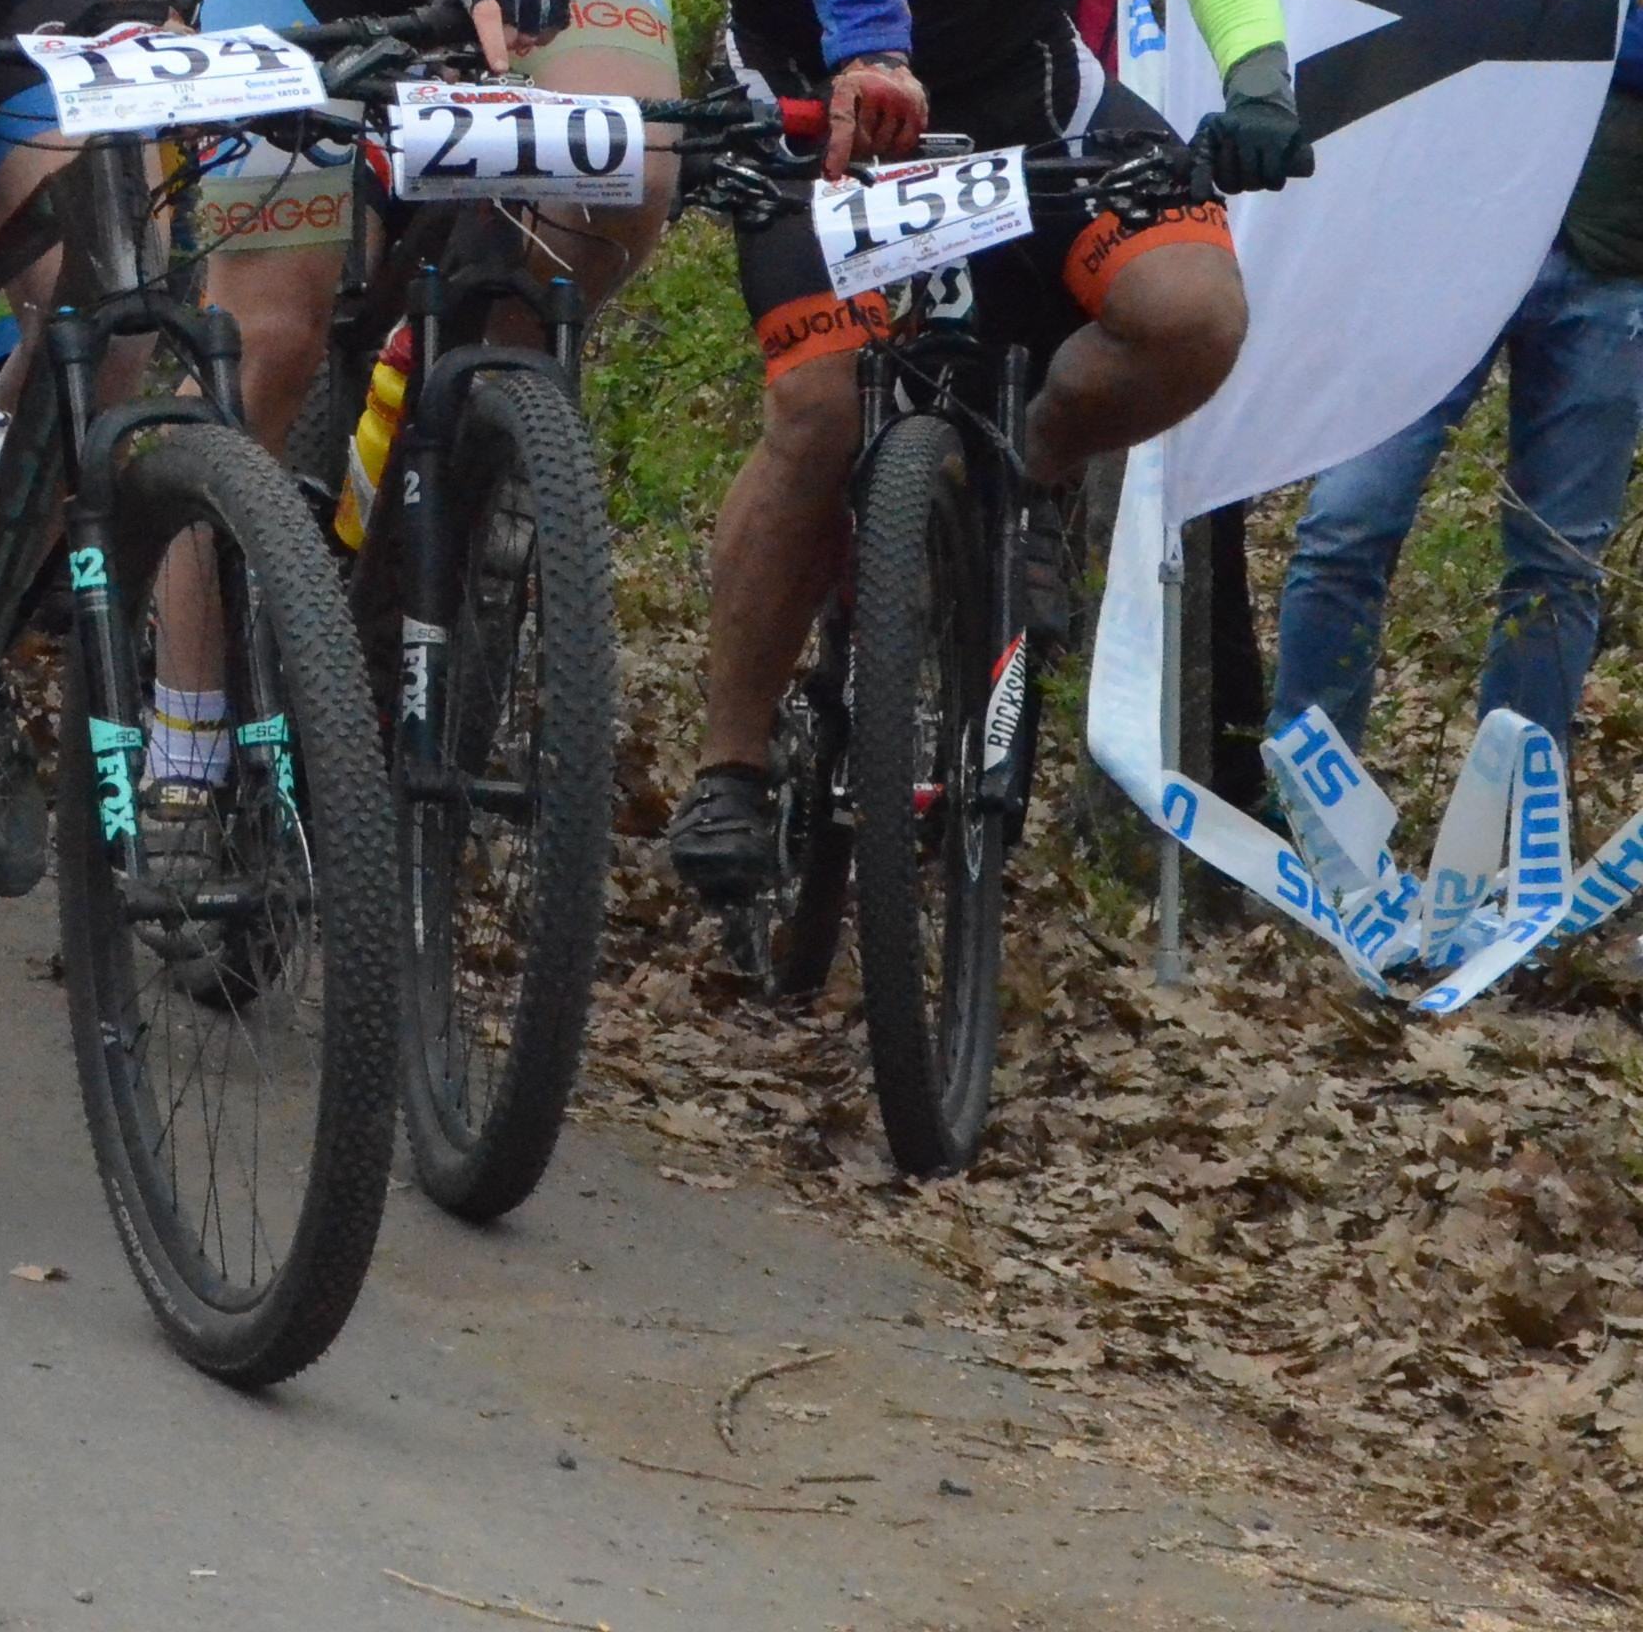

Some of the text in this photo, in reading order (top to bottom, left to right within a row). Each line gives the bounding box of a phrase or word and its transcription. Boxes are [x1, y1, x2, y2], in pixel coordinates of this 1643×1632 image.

[58, 34, 292, 89] 154
[418, 104, 628, 177] 210
[832, 157, 1011, 259] 158
[402, 645, 428, 722] FOX
[96, 750, 137, 841] FOX
